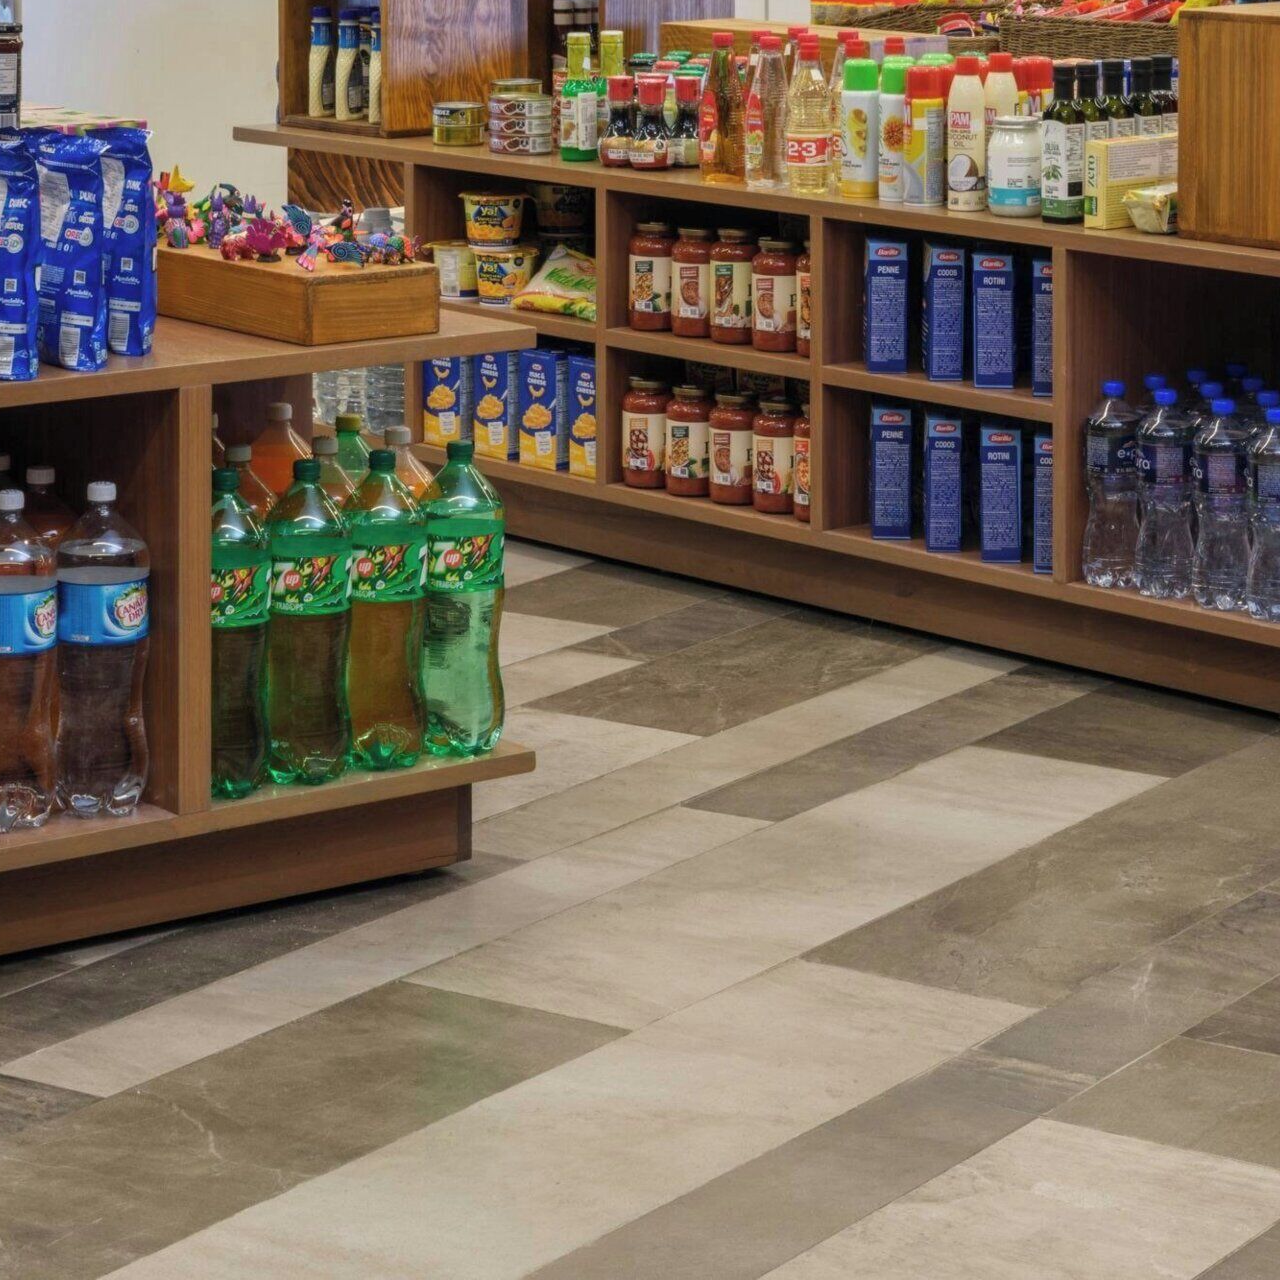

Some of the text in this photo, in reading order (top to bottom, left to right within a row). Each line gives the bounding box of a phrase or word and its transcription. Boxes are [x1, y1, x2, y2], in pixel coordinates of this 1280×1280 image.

[950, 112, 970, 126] PAM
[877, 266, 900, 274] PENNE
[983, 276, 1006, 285] ROTINI
[881, 431, 904, 439] PENNE
[988, 452, 1010, 460] ROTINI
[128, 606, 144, 622] DRY
